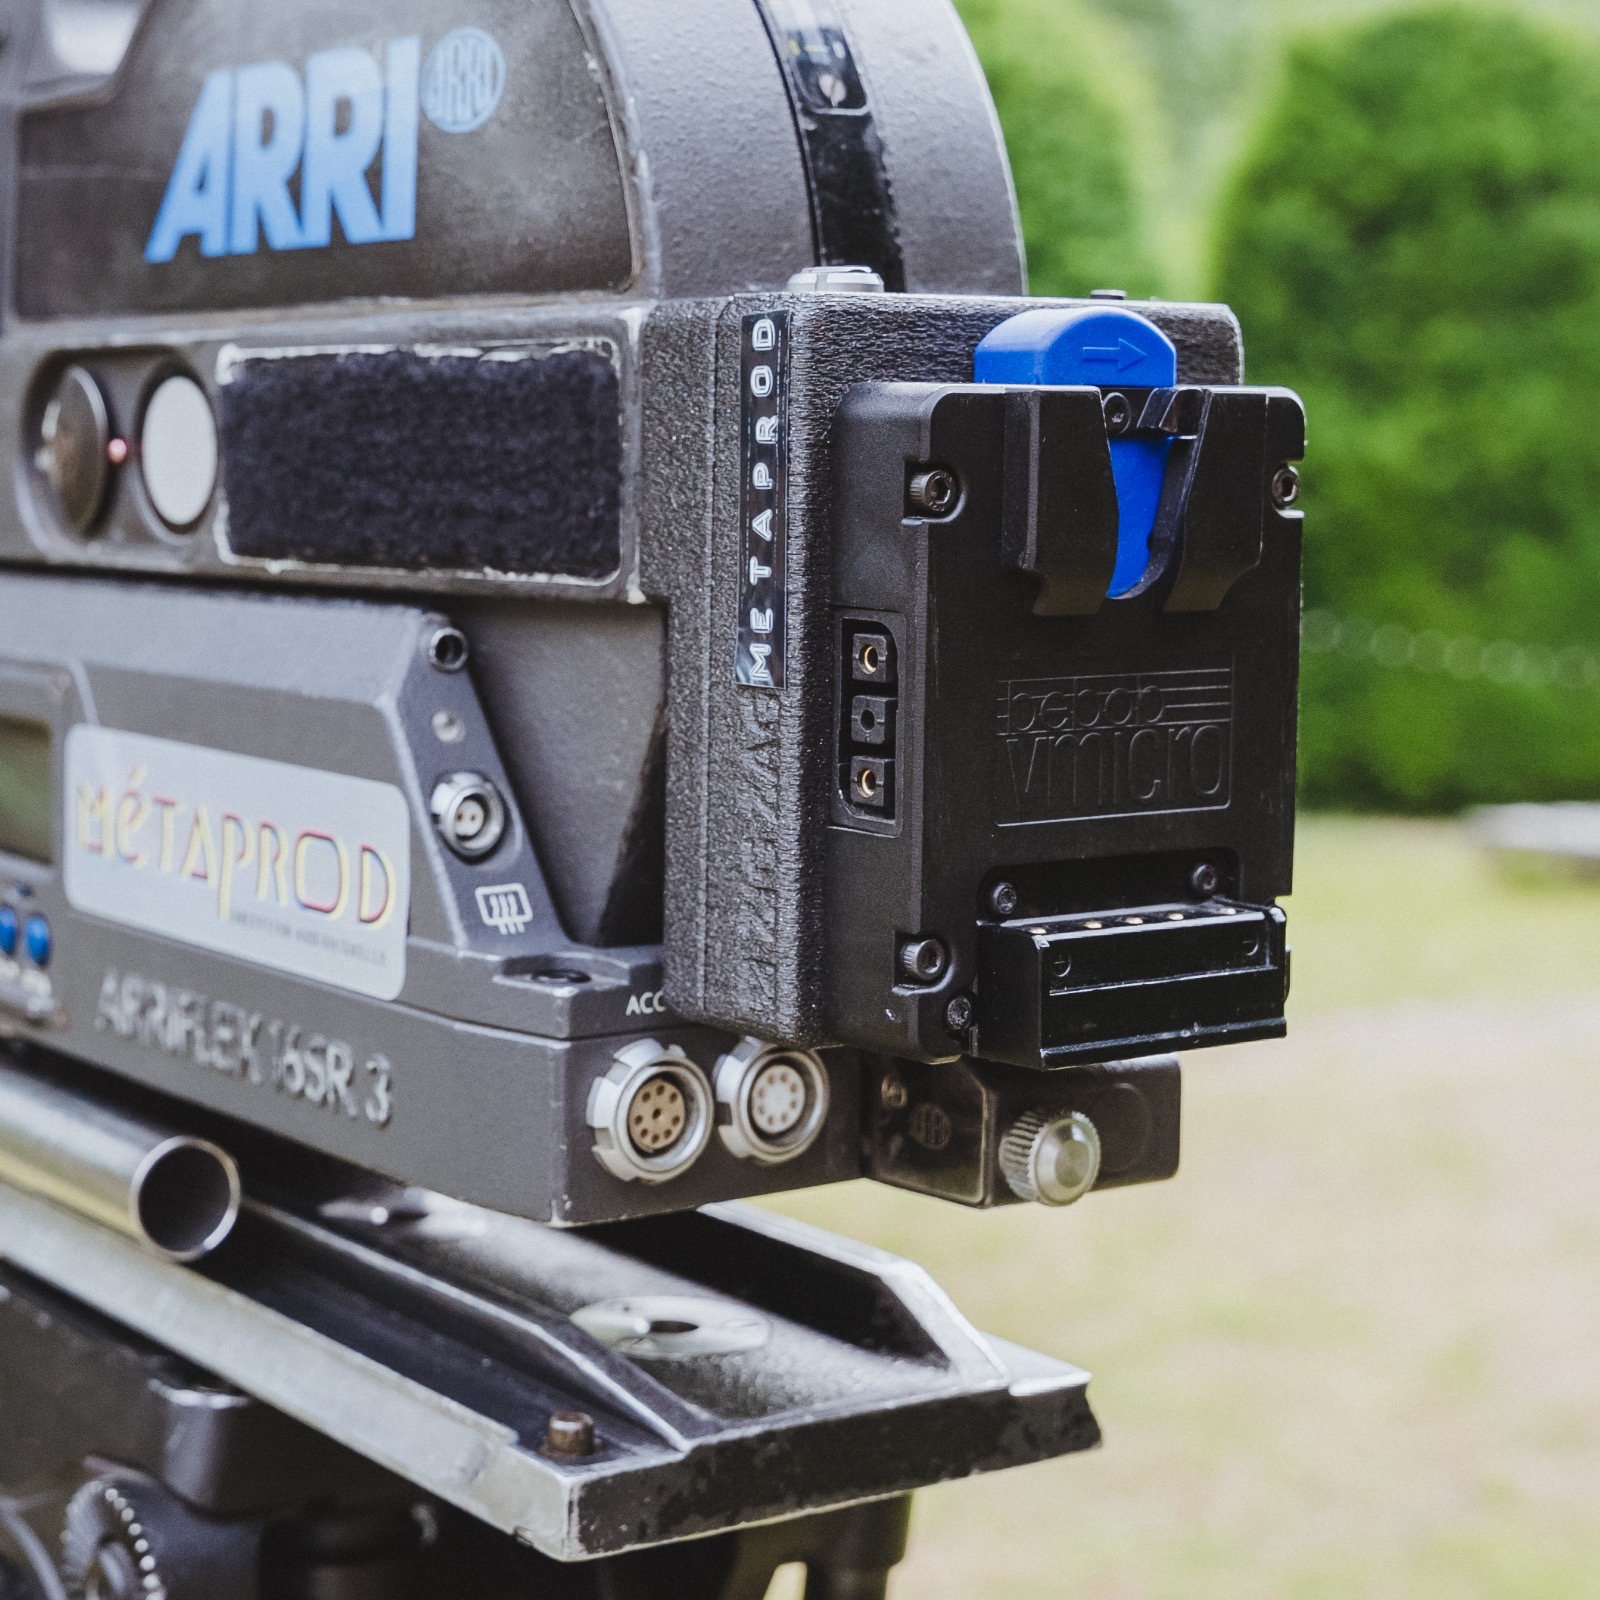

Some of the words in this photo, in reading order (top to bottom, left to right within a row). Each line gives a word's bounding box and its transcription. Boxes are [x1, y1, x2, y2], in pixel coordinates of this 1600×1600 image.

[144, 37, 421, 264] ARRI
[750, 318, 779, 683] METAPROD
[366, 1053, 391, 1123] 3
